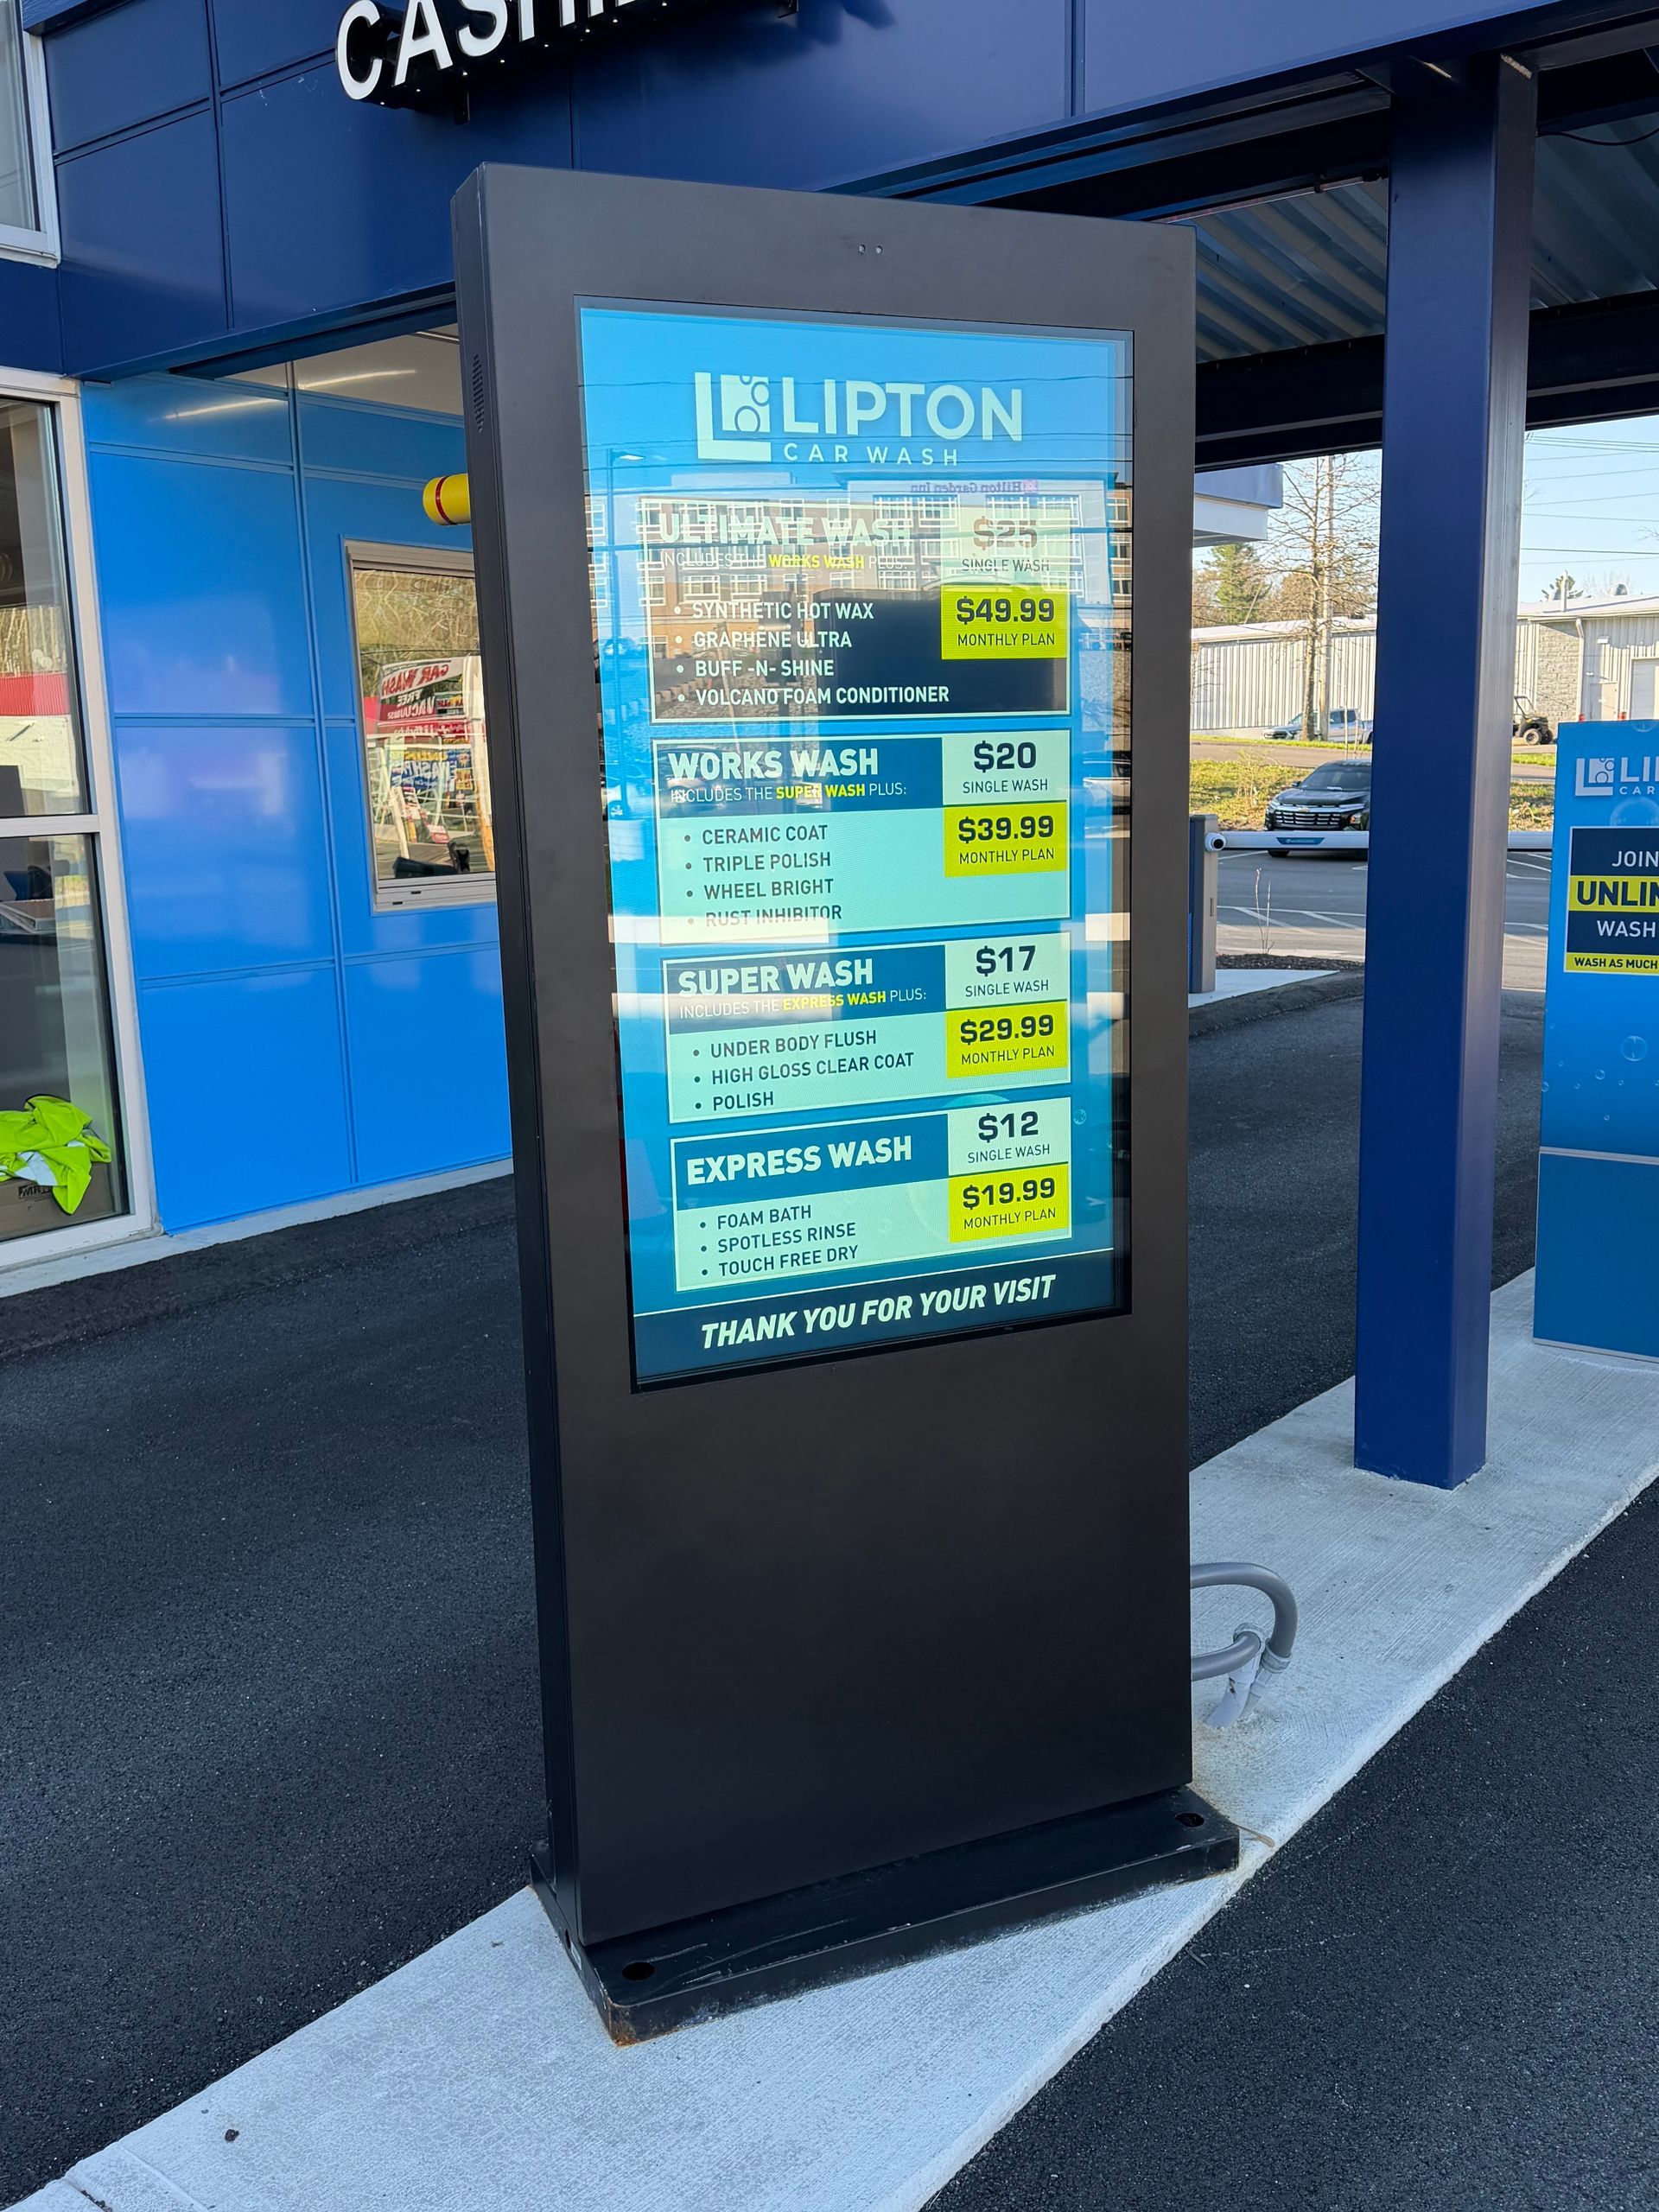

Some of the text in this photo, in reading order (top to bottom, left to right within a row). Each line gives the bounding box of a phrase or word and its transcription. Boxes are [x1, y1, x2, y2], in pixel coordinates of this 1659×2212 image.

[782, 377, 1022, 441] LIPTON
[784, 442, 957, 466] CAR WASH
[658, 513, 911, 547] ULTIMATE WASH
[973, 516, 1037, 550] $25
[660, 552, 733, 568] INCLUDES
[768, 554, 820, 569] WORKS
[823, 555, 864, 569] WASH
[962, 558, 1050, 572] SINGLE WASH
[691, 601, 874, 620] SYNTHETIC HOT WAX
[957, 595, 1054, 625] $49.99
[694, 631, 853, 648] GRAPHENE ULTRA
[957, 632, 1055, 646] MONTHLY PLAN
[695, 659, 835, 677] BUFF -N- SHINE
[695, 686, 950, 706] VOLCANO FOAM CONDITIONER
[668, 747, 879, 781] WORKS WASH
[974, 741, 1037, 772] $20
[671, 782, 906, 803] INCLUDES THE SUPER WASH PLUS:
[963, 779, 1048, 794] SINGLE WASH
[1619, 785, 1656, 795] CAR
[702, 825, 828, 845] CERAMIC COAT
[958, 816, 1054, 844] $39.99
[702, 852, 831, 873] TRIPLE POLISH
[959, 848, 1054, 865] MONTHLY PLAN
[1611, 850, 1659, 868] JOIN
[704, 879, 834, 899] WHEEL BRIGHT
[706, 905, 842, 927] RUST INHIBITOR
[1597, 920, 1656, 938] WASH
[976, 945, 1036, 977] $17
[1574, 957, 1658, 969] WASH AS MUCH
[678, 958, 874, 998] SUPER WASH
[965, 979, 1049, 997] SINGLE WASH
[680, 988, 927, 1020] INCLUDES THE EXPRESS WASH PLUS:
[960, 1014, 1054, 1046] $29.99
[711, 1030, 877, 1058] UNDER BODY FLUSH
[961, 1046, 1055, 1065] MONTHLY PLAN
[712, 1052, 914, 1084] HIGH GLOSS CLEAR COAT
[713, 1091, 774, 1110] POLISH
[978, 1111, 1039, 1143] $12
[687, 1135, 912, 1185] EXPRESS WASH
[968, 1143, 1050, 1163] SINGLE WASH
[963, 1178, 1055, 1211] $19.99
[717, 1205, 811, 1230] FOAM BATH
[963, 1207, 1056, 1230] MONTHLY PLAN
[718, 1222, 855, 1253] SPOTLESS RINSE
[718, 1244, 858, 1276] TOUCH FREE DRY
[701, 1274, 1057, 1349] THANK YOU FOR YOUR VISIT
